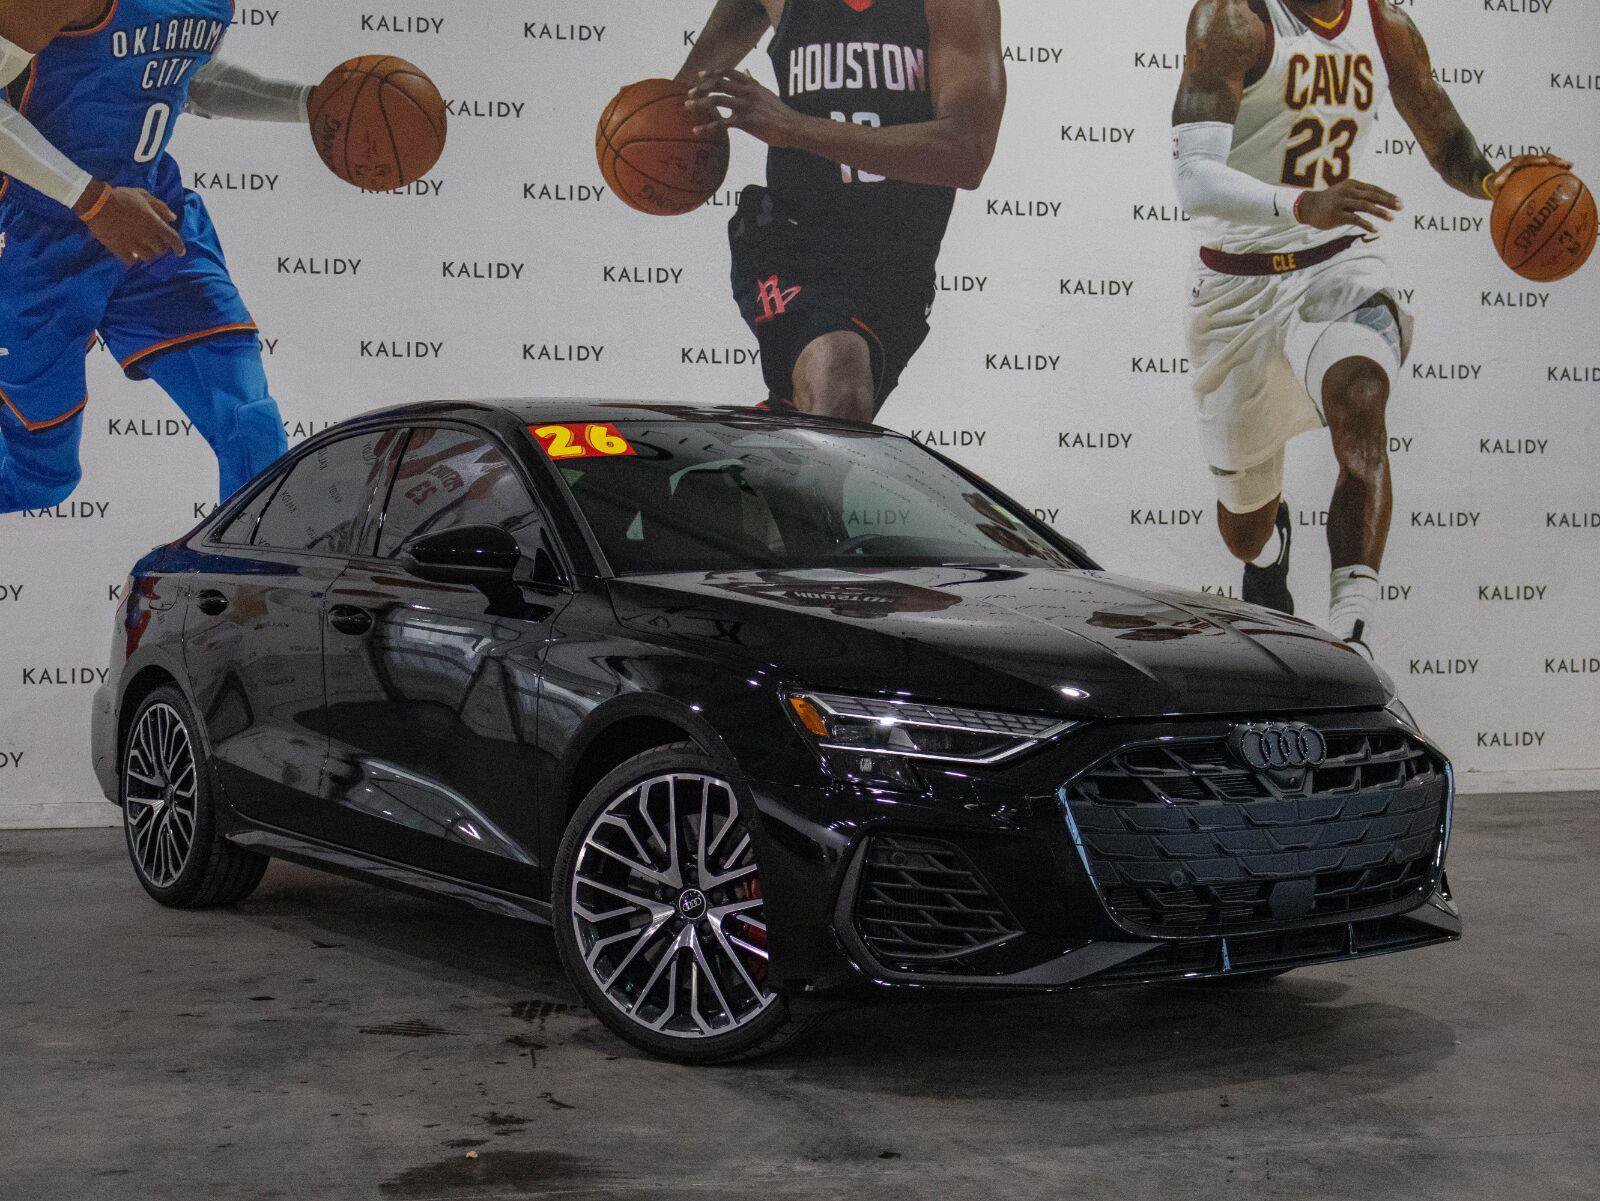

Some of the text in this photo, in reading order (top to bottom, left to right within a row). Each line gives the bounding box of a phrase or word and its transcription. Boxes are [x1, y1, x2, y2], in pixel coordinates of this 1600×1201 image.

[361, 14, 444, 34] KALIDY
[524, 22, 606, 42] KALIDY
[112, 18, 224, 58] OKLAHOM
[1003, 46, 1063, 64] ALIDY
[141, 58, 194, 89] CITY
[788, 42, 926, 97] HOUSTON
[1431, 67, 1485, 85] ALIDY
[1284, 52, 1374, 112] CAVS
[133, 102, 170, 163] 0
[1061, 125, 1135, 144] KALIDY
[1280, 115, 1359, 188] 23
[193, 172, 279, 191] KALIDY
[523, 183, 605, 202] KALIDY
[987, 199, 1062, 218] KALIDY
[1414, 214, 1483, 232] KALIDY
[277, 256, 362, 276] KALIDY
[442, 261, 525, 281] KALIDY
[1272, 252, 1297, 272] CLE
[603, 265, 684, 285] KALIDY
[1060, 278, 1134, 297] KALIDY
[1481, 291, 1550, 308] KALIDY
[360, 340, 444, 359] KALIDY
[523, 343, 605, 362] KALIDY
[681, 347, 760, 365] KALIDY
[986, 354, 1061, 371] KALIDY
[1132, 357, 1190, 374] KALID
[1412, 363, 1482, 380] KALIDY
[1547, 366, 1600, 382] KALID
[108, 417, 193, 437] KALIDY
[535, 424, 628, 457] 26
[911, 430, 986, 447] KALIDY
[1058, 432, 1133, 449] KALIDY
[1480, 438, 1548, 454] KALIDY
[1130, 509, 1203, 525] KALIDY
[1411, 511, 1480, 528] KALIDY
[1546, 512, 1600, 528] KALID
[1478, 585, 1547, 601] KALIDY
[1410, 659, 1479, 675] KALIDY
[1545, 658, 1600, 674] KALID
[22, 667, 110, 686] KALIDY
[1477, 731, 1546, 748] KALIDY
